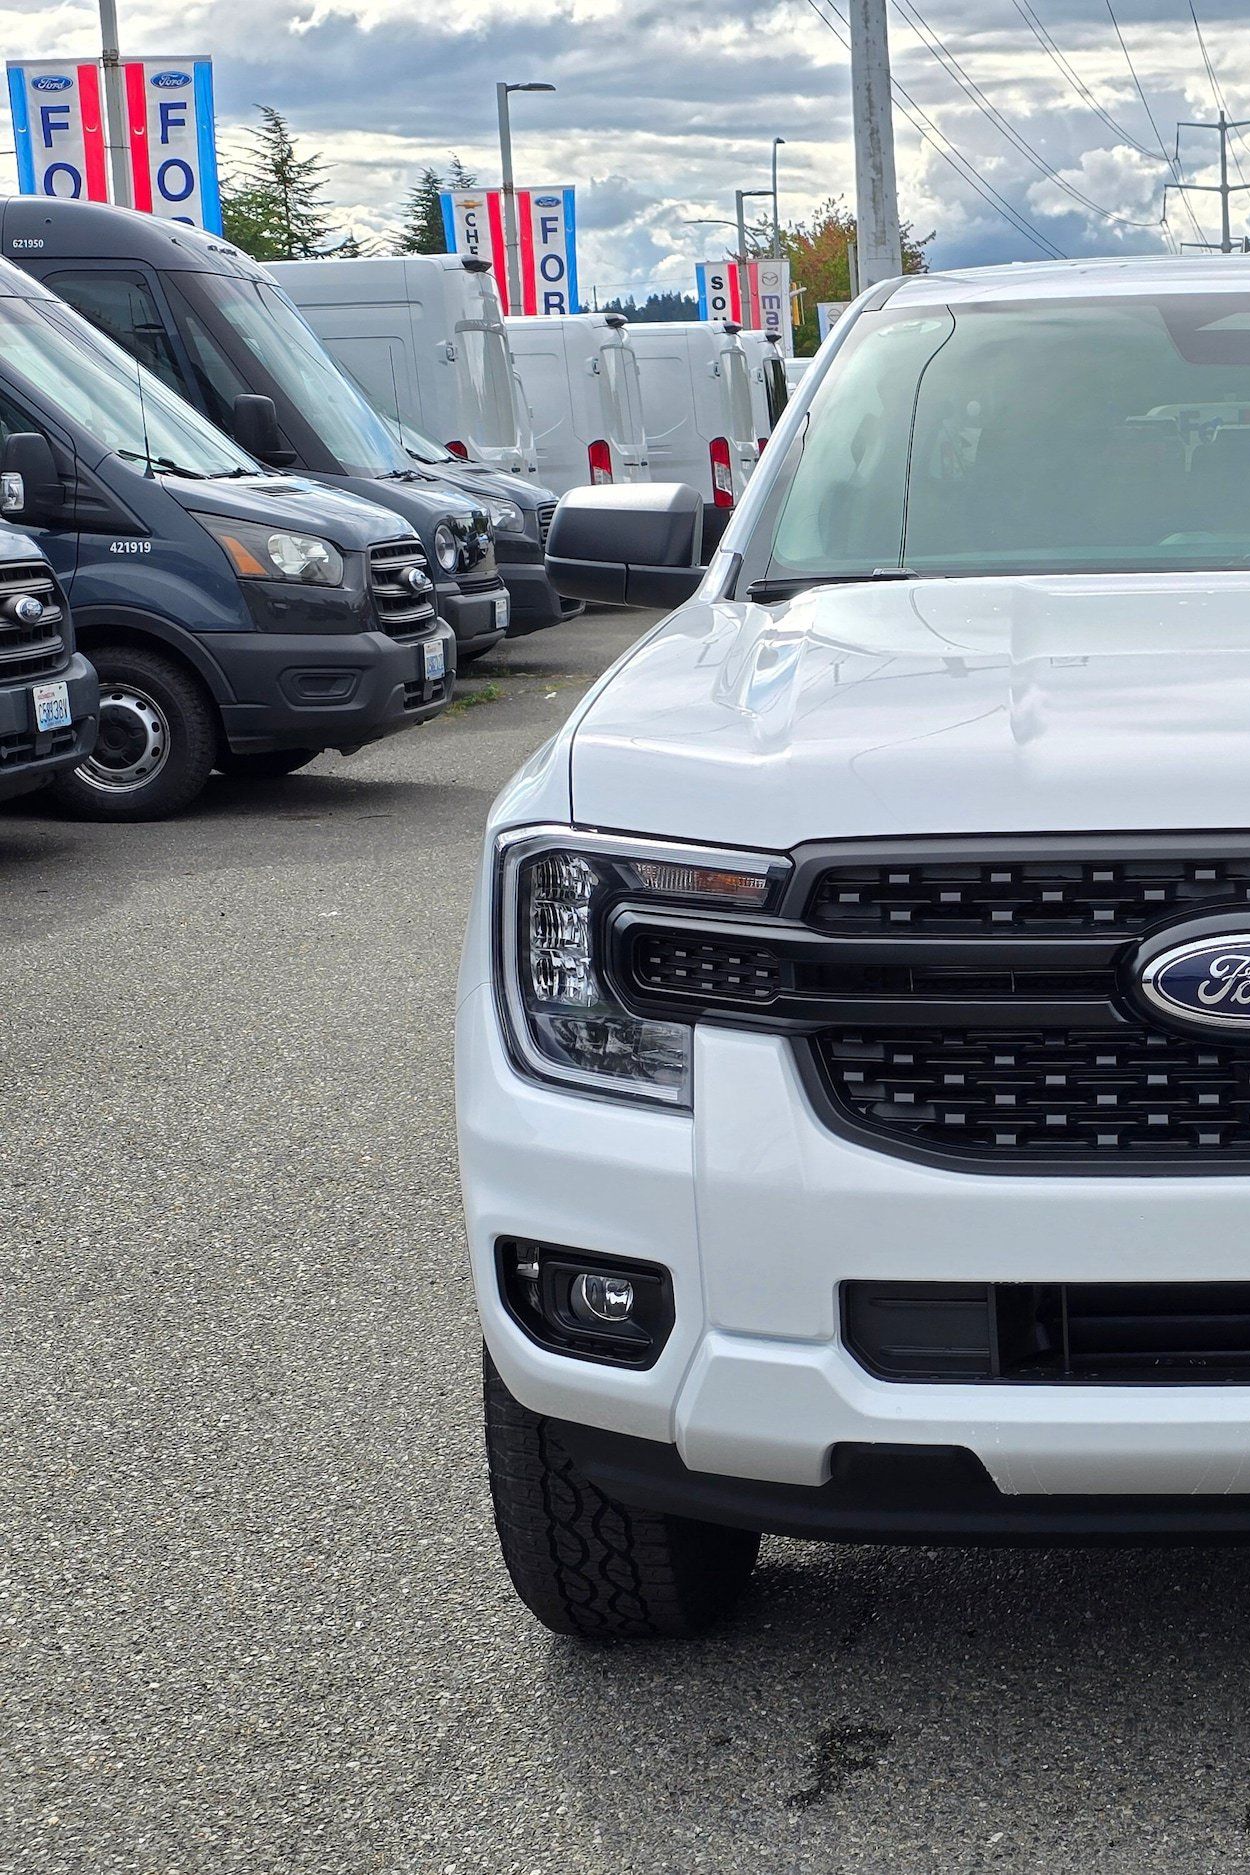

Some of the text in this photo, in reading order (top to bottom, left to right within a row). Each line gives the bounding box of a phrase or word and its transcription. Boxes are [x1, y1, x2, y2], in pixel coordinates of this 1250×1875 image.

[158, 102, 196, 226] FO
[12, 238, 44, 249] 621950
[710, 275, 727, 321] SO
[761, 295, 781, 331] ma
[109, 540, 152, 555] 421919
